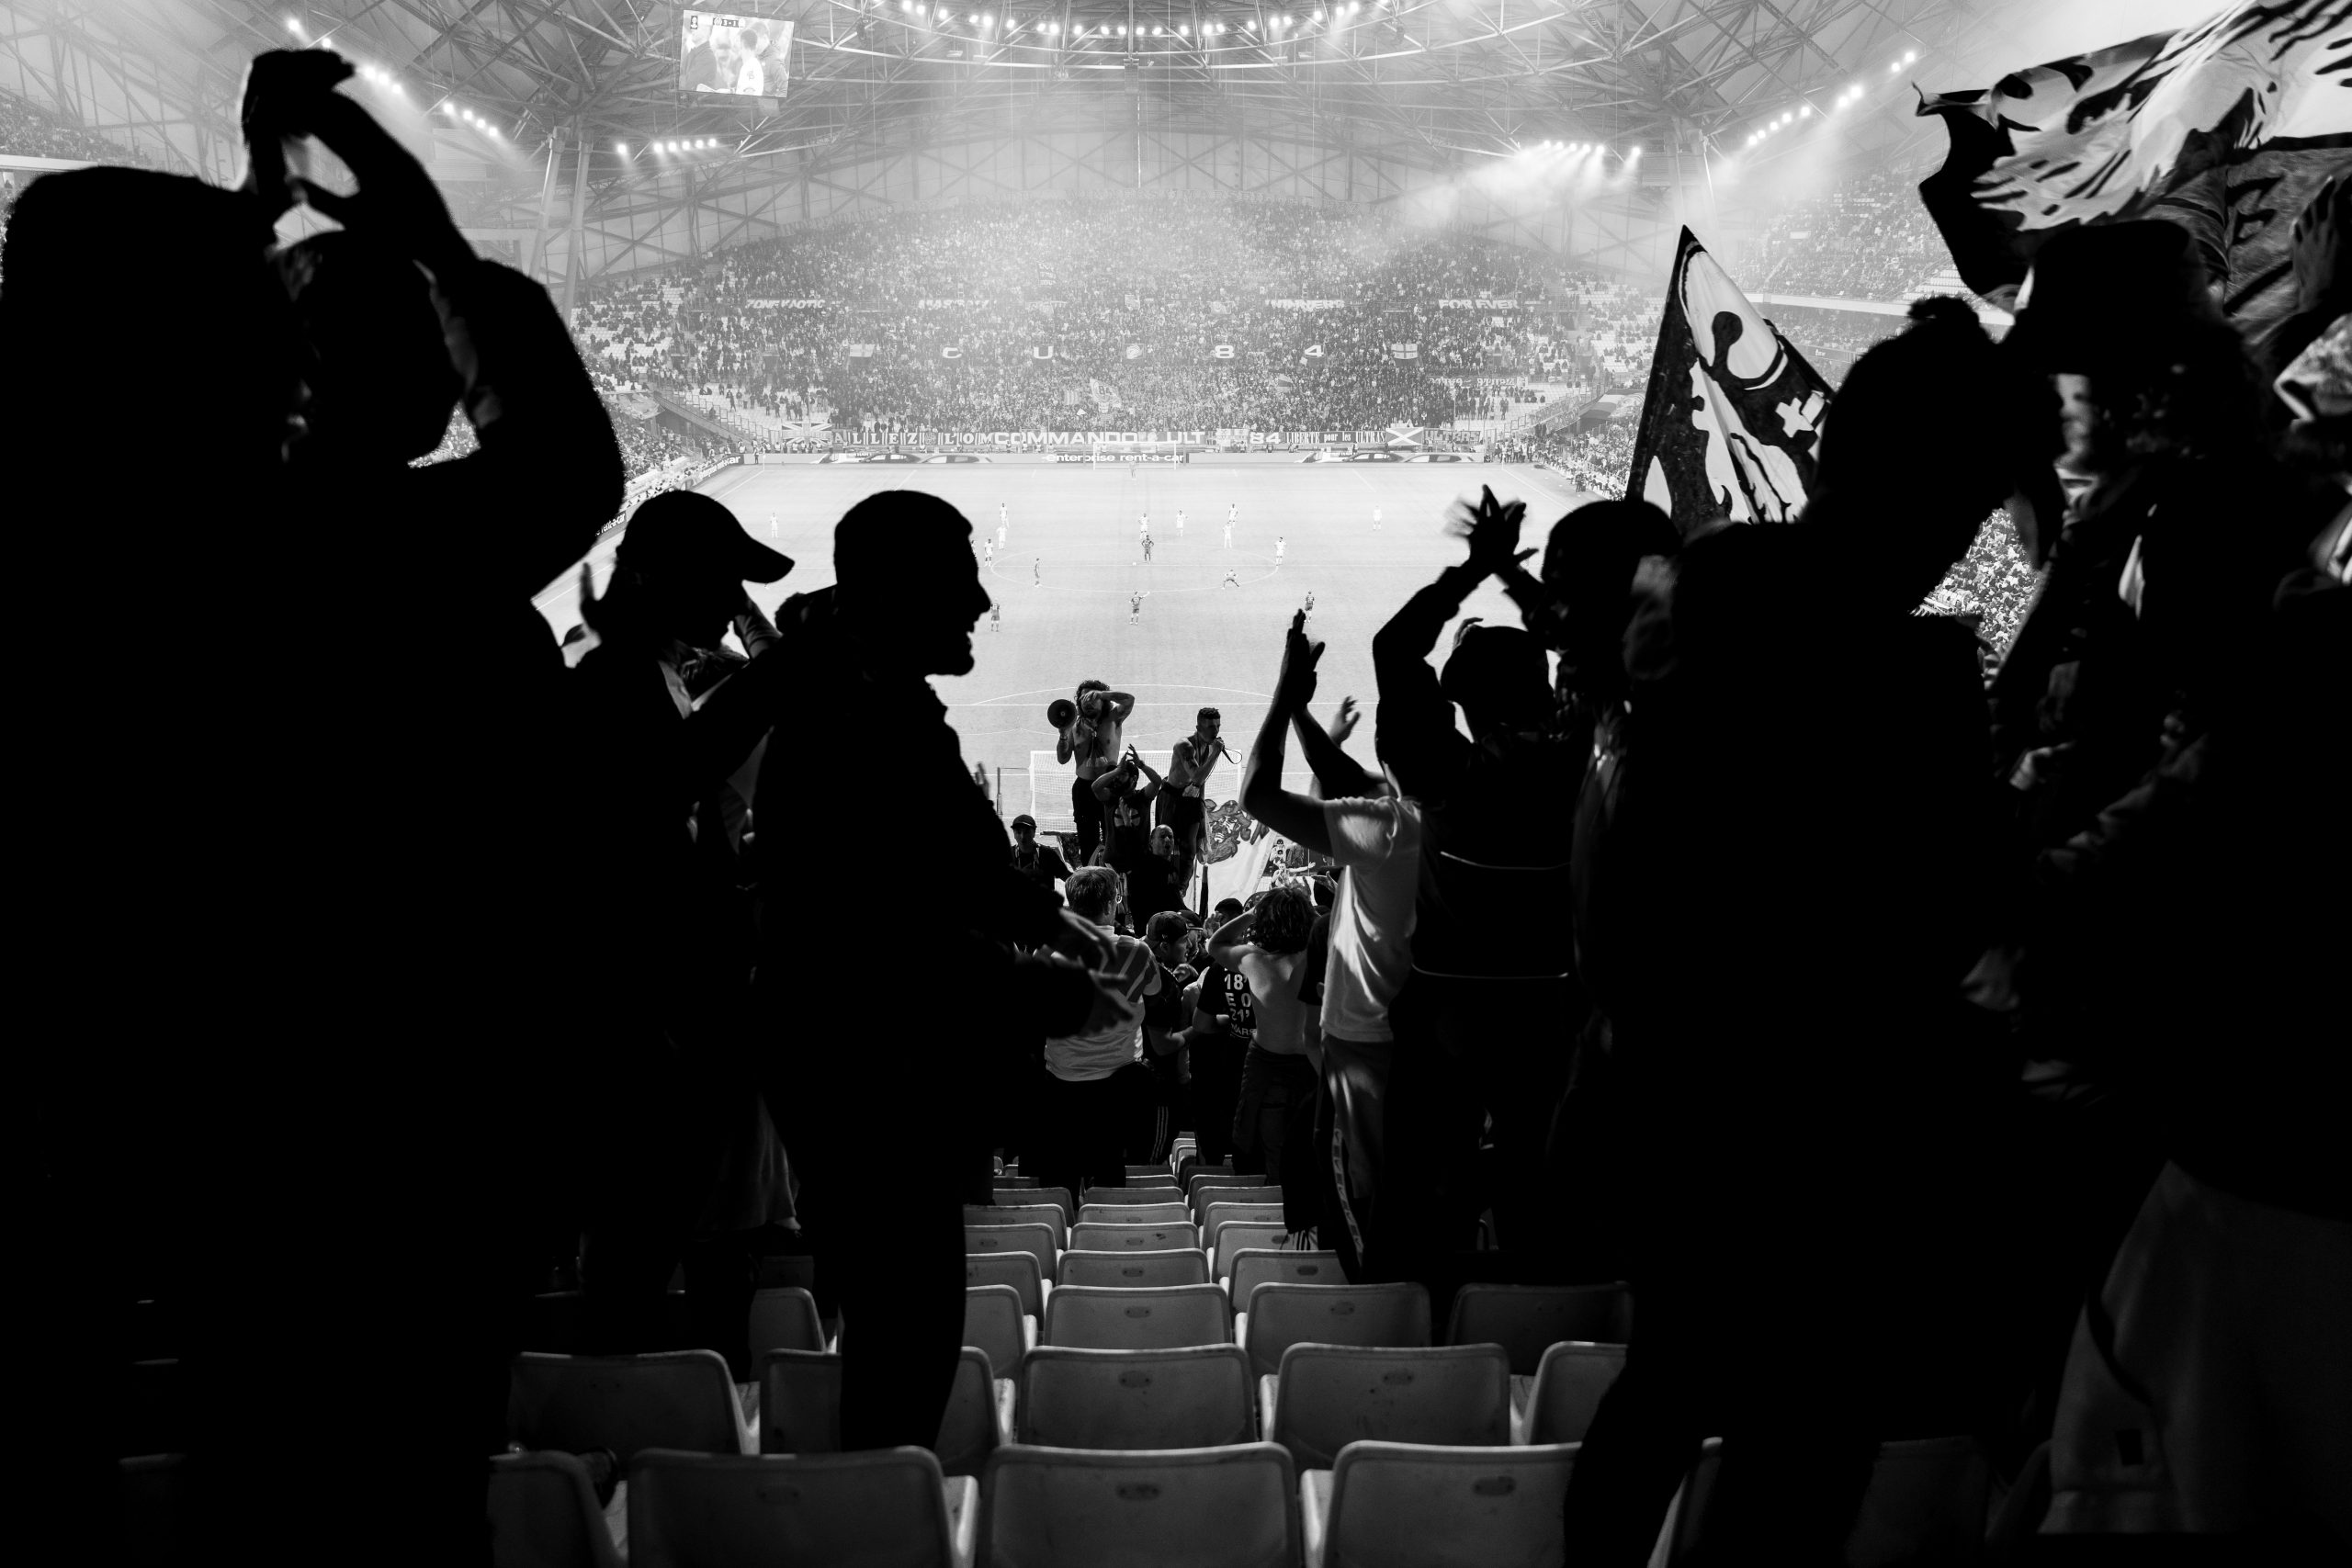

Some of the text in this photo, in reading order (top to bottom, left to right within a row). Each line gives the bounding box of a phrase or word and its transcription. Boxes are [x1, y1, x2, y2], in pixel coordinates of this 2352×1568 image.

[1438, 299, 1473, 310] FOR
[942, 344, 1324, 359] C U 8 4
[834, 432, 918, 446] ALLEZ
[994, 431, 1138, 445] COMMANDO
[1250, 432, 1282, 445] 84
[1323, 433, 1338, 443] pour
[1342, 432, 1351, 442] les
[1355, 432, 1386, 444] ULTRAS
[1046, 454, 1184, 463] enterprise rent-a-car
